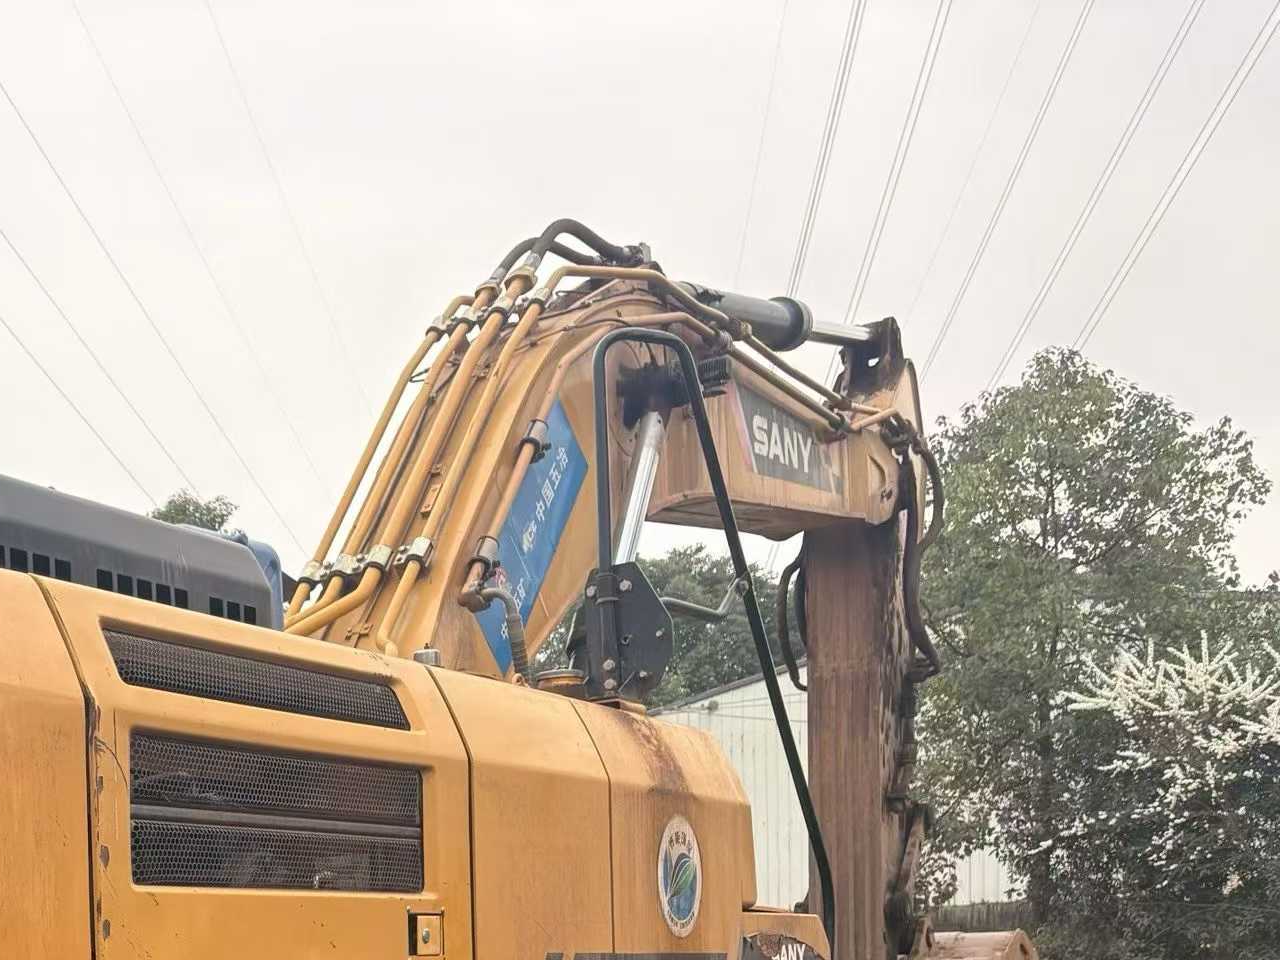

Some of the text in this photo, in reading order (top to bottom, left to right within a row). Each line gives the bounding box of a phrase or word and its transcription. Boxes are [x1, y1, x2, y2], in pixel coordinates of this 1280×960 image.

[753, 415, 812, 473] SANY
[535, 447, 568, 521] 中国五冶
[500, 577, 526, 640] 中五矿
